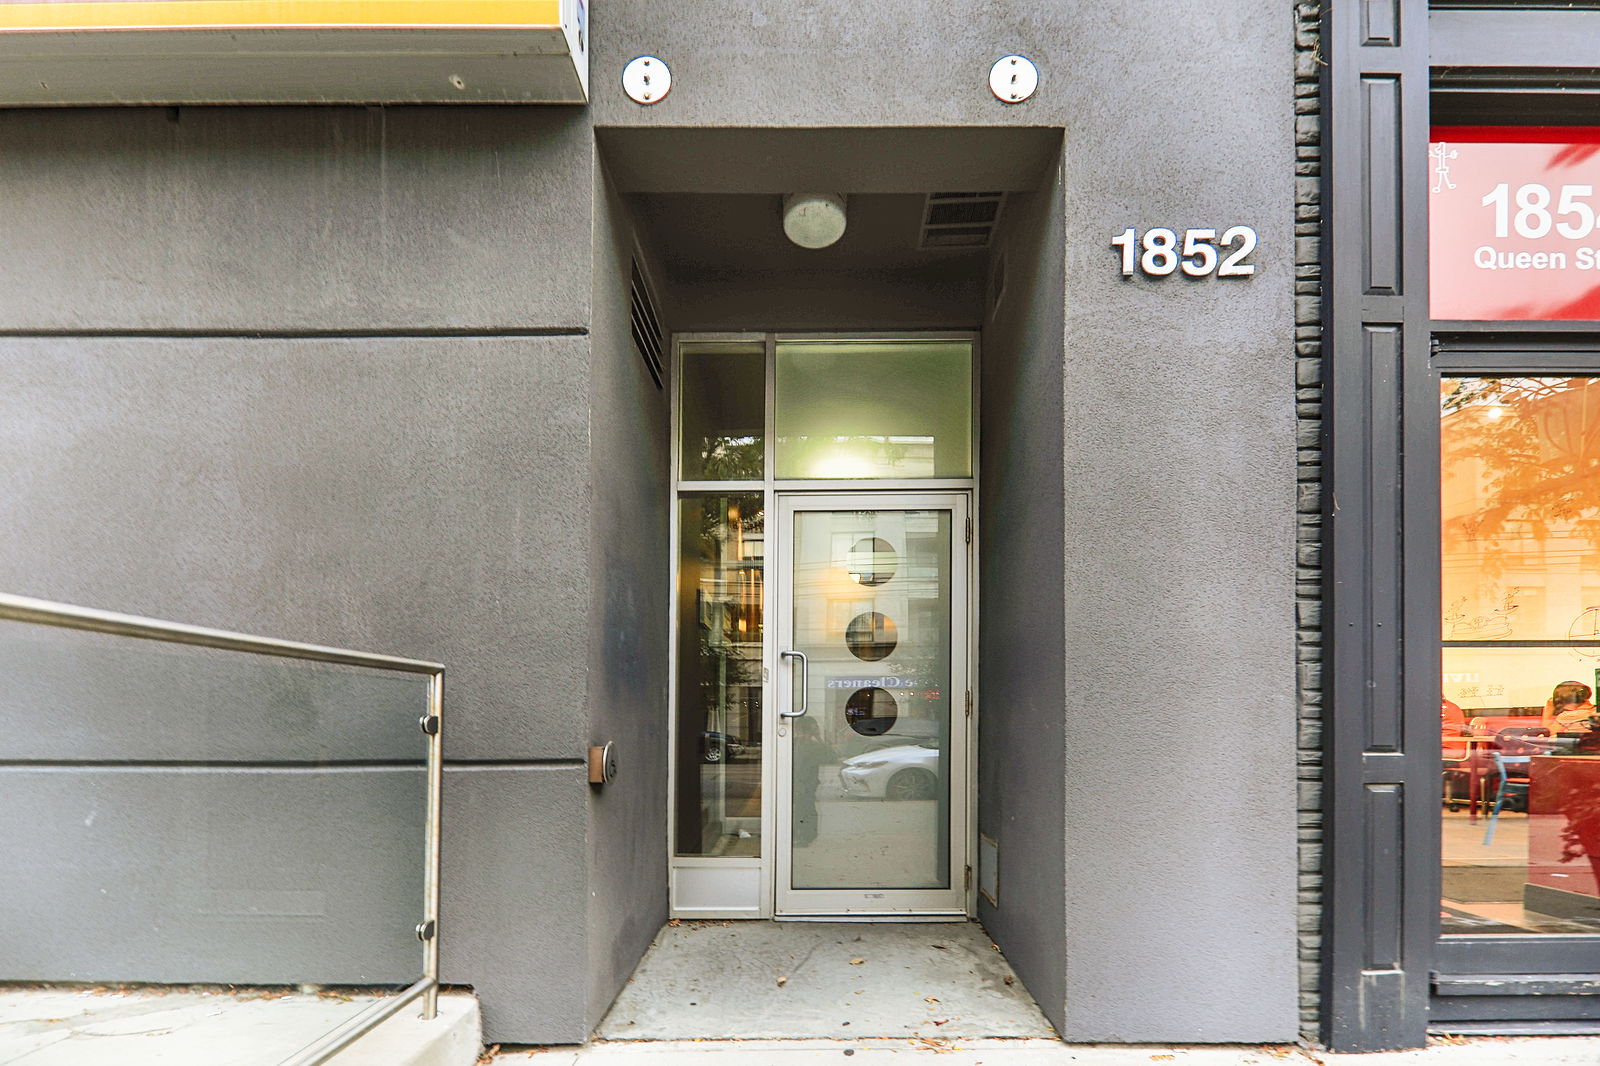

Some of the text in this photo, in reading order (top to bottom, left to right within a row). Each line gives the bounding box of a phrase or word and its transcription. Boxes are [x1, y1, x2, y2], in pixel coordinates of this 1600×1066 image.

[1481, 183, 1600, 240] 185
[1111, 225, 1257, 277] 1852
[1474, 246, 1566, 270] Queen
